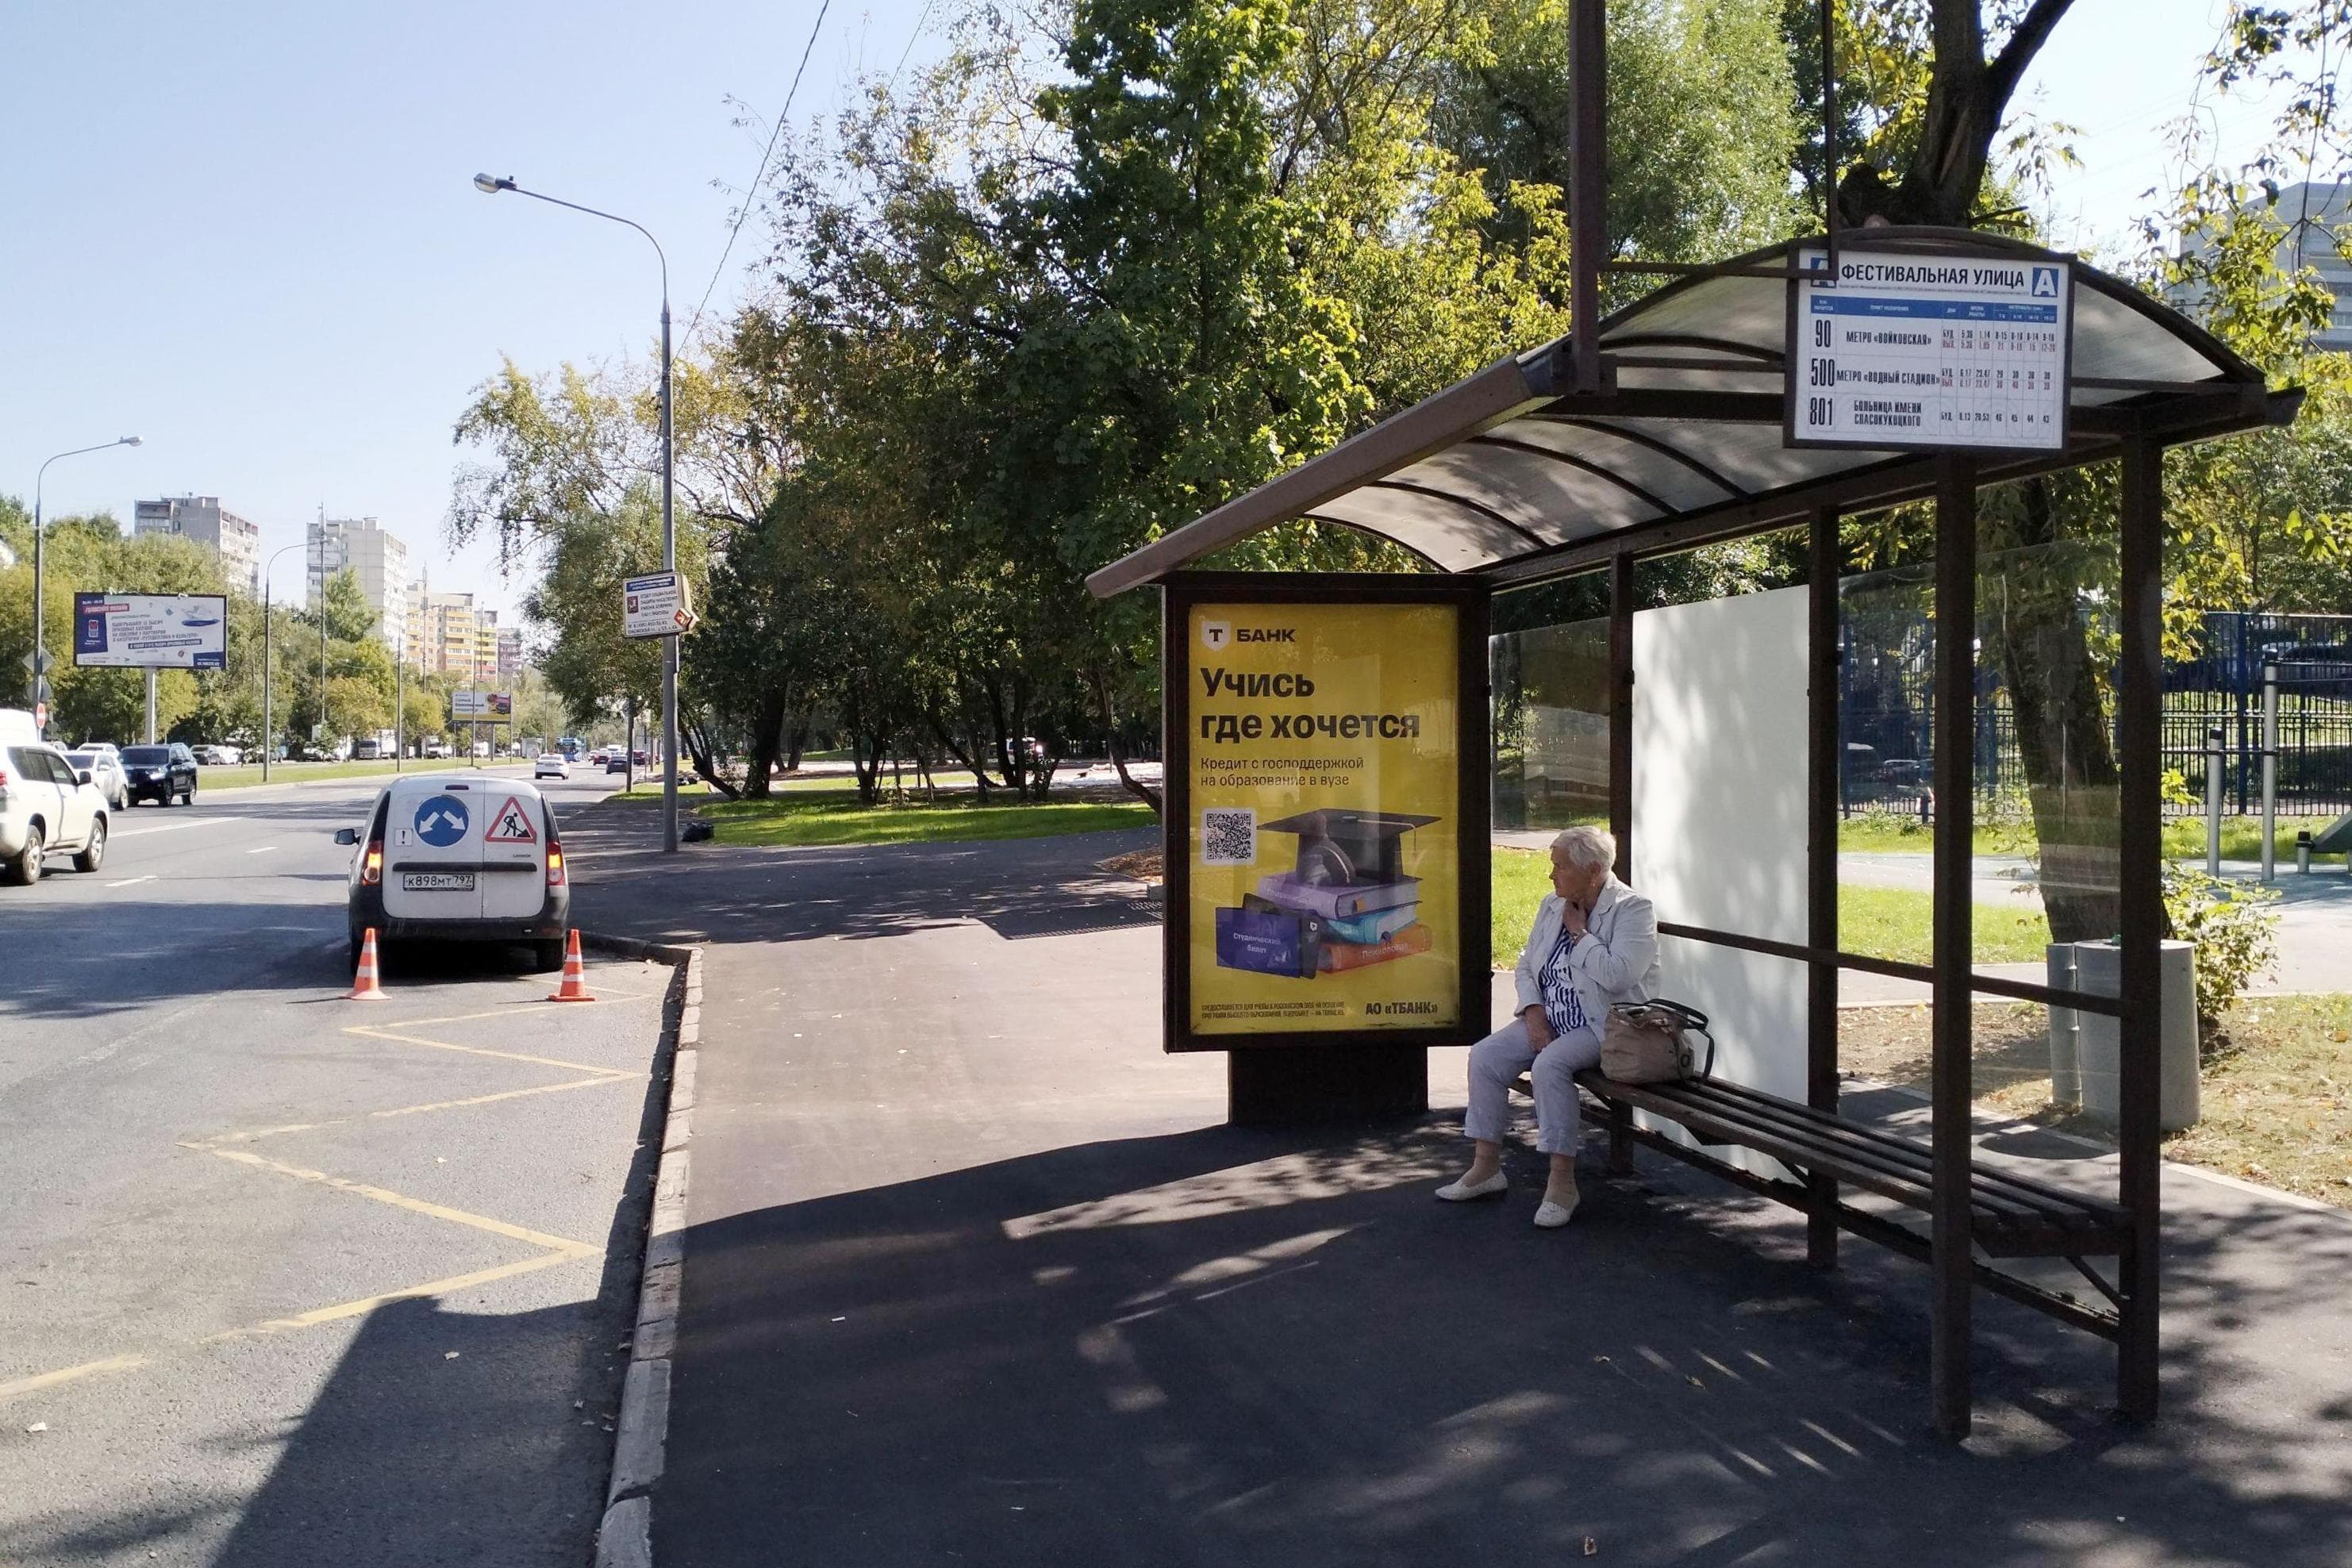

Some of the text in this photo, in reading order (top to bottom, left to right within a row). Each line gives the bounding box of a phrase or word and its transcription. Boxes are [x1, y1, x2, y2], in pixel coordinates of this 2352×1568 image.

[1842, 264, 1968, 284] ФЕСТИВАЛЬНАЯ
[1973, 269, 2024, 289] УЛИЦА
[2034, 269, 2057, 296] А
[1816, 319, 1831, 348] 90
[1846, 331, 1931, 345] МЕТРО «ВОЙКОВСКАЯ»
[1811, 358, 1835, 386] 500
[1836, 370, 1940, 386] МЕТРО «ВОДНЫЙ СТАДИОН»
[1810, 398, 1832, 425] 801
[1854, 400, 1922, 413] БОЛЬНИЦА ИМЕНИ
[1854, 413, 1921, 427] СПАСОКУКОЦКОГО
[1236, 628, 1296, 642] БАНК
[1200, 667, 1315, 698] Учись
[1200, 714, 1420, 744] где хочется
[1201, 756, 1364, 772] Кредит с господдержкой
[1201, 774, 1349, 788] на образование в вузе
[1366, 1001, 1438, 1015] АО «ТБАНК»
